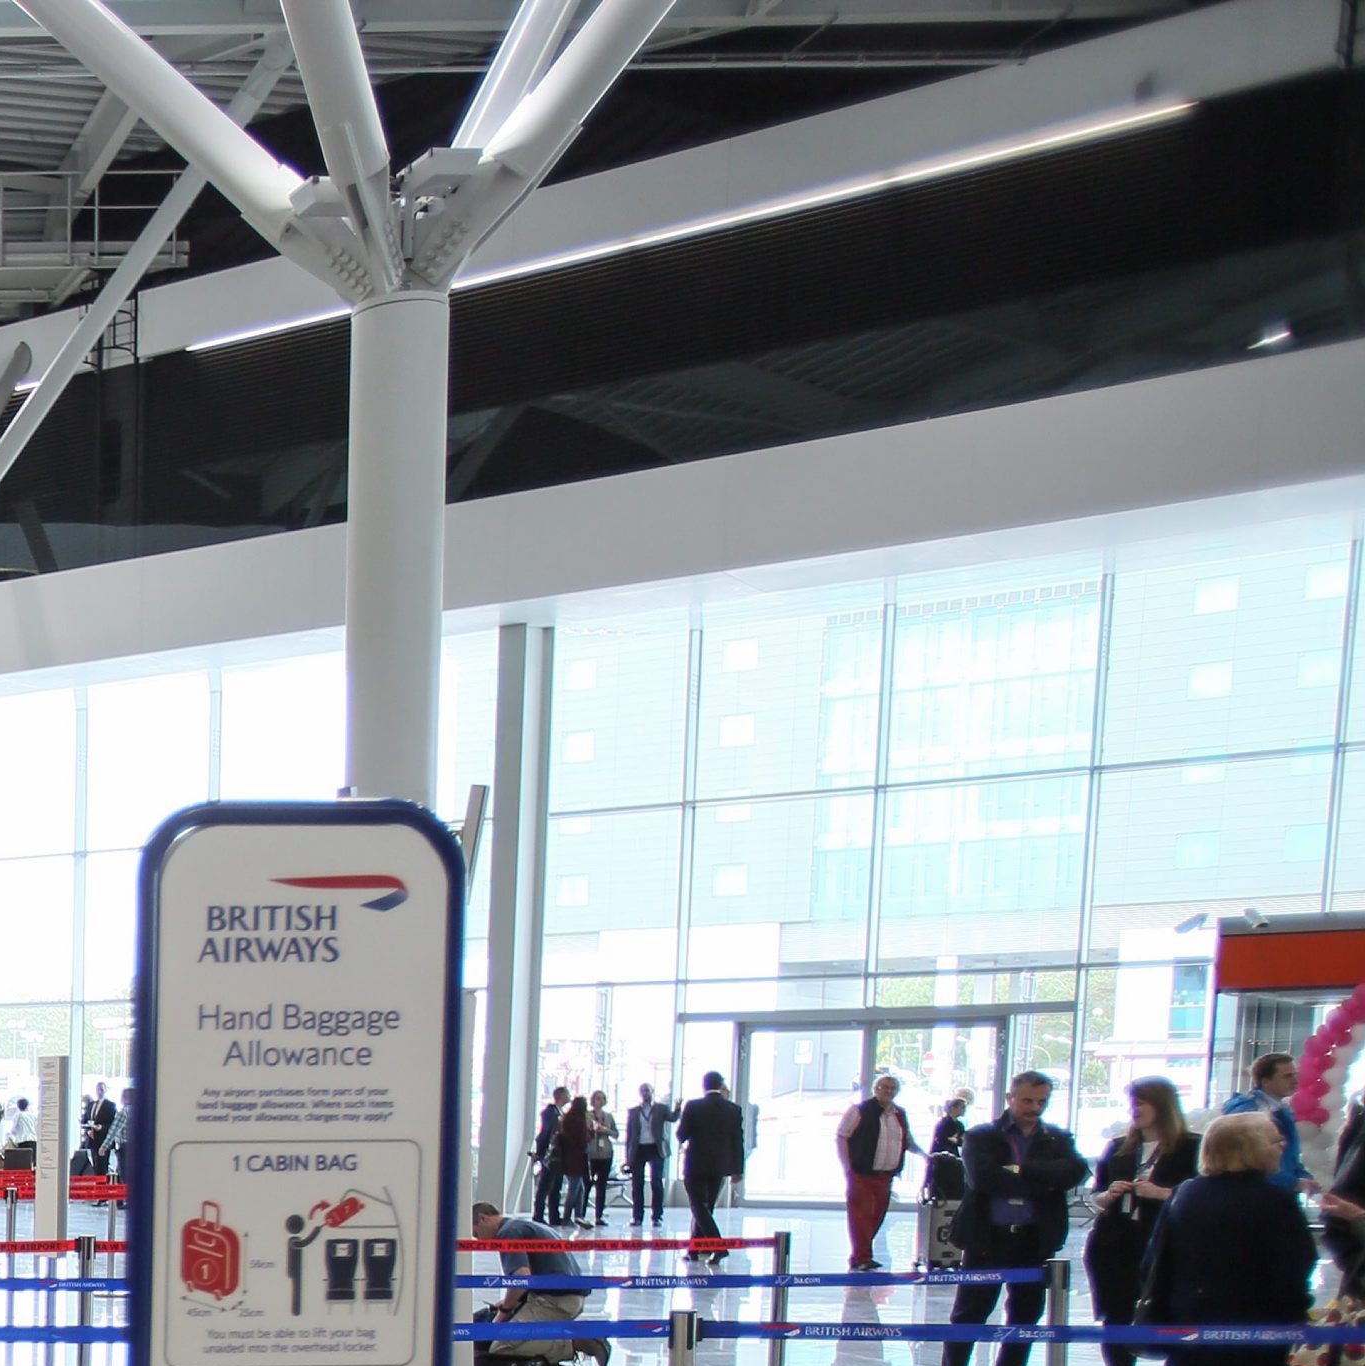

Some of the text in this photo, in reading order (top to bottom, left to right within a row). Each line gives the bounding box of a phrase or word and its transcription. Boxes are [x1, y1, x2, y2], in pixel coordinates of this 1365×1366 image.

[207, 905, 337, 931] BRITISH
[197, 936, 340, 963] AIRWAYS
[198, 1004, 400, 1036] Hand Baggage
[222, 1040, 373, 1067] Allowance
[233, 1154, 358, 1172] 1 CABIN BAG
[501, 1278, 529, 1286] ba.com
[635, 1277, 708, 1286] BRITISH AIRWAYS
[794, 1276, 820, 1284] ba.com
[928, 1273, 1002, 1282] BRITISH AIRWAYS
[206, 1329, 227, 1339] You
[229, 1330, 255, 1339] must
[258, 1328, 271, 1339] be
[274, 1328, 296, 1339] able
[299, 1329, 310, 1338] to
[329, 1330, 353, 1340] your
[356, 1328, 376, 1340] bag
[804, 1326, 902, 1337] BRITISH AIRWAYS
[1019, 1329, 1055, 1339] ba.com
[1204, 1330, 1305, 1341] BRITISH AIRWAYS
[270, 1343, 289, 1353] the
